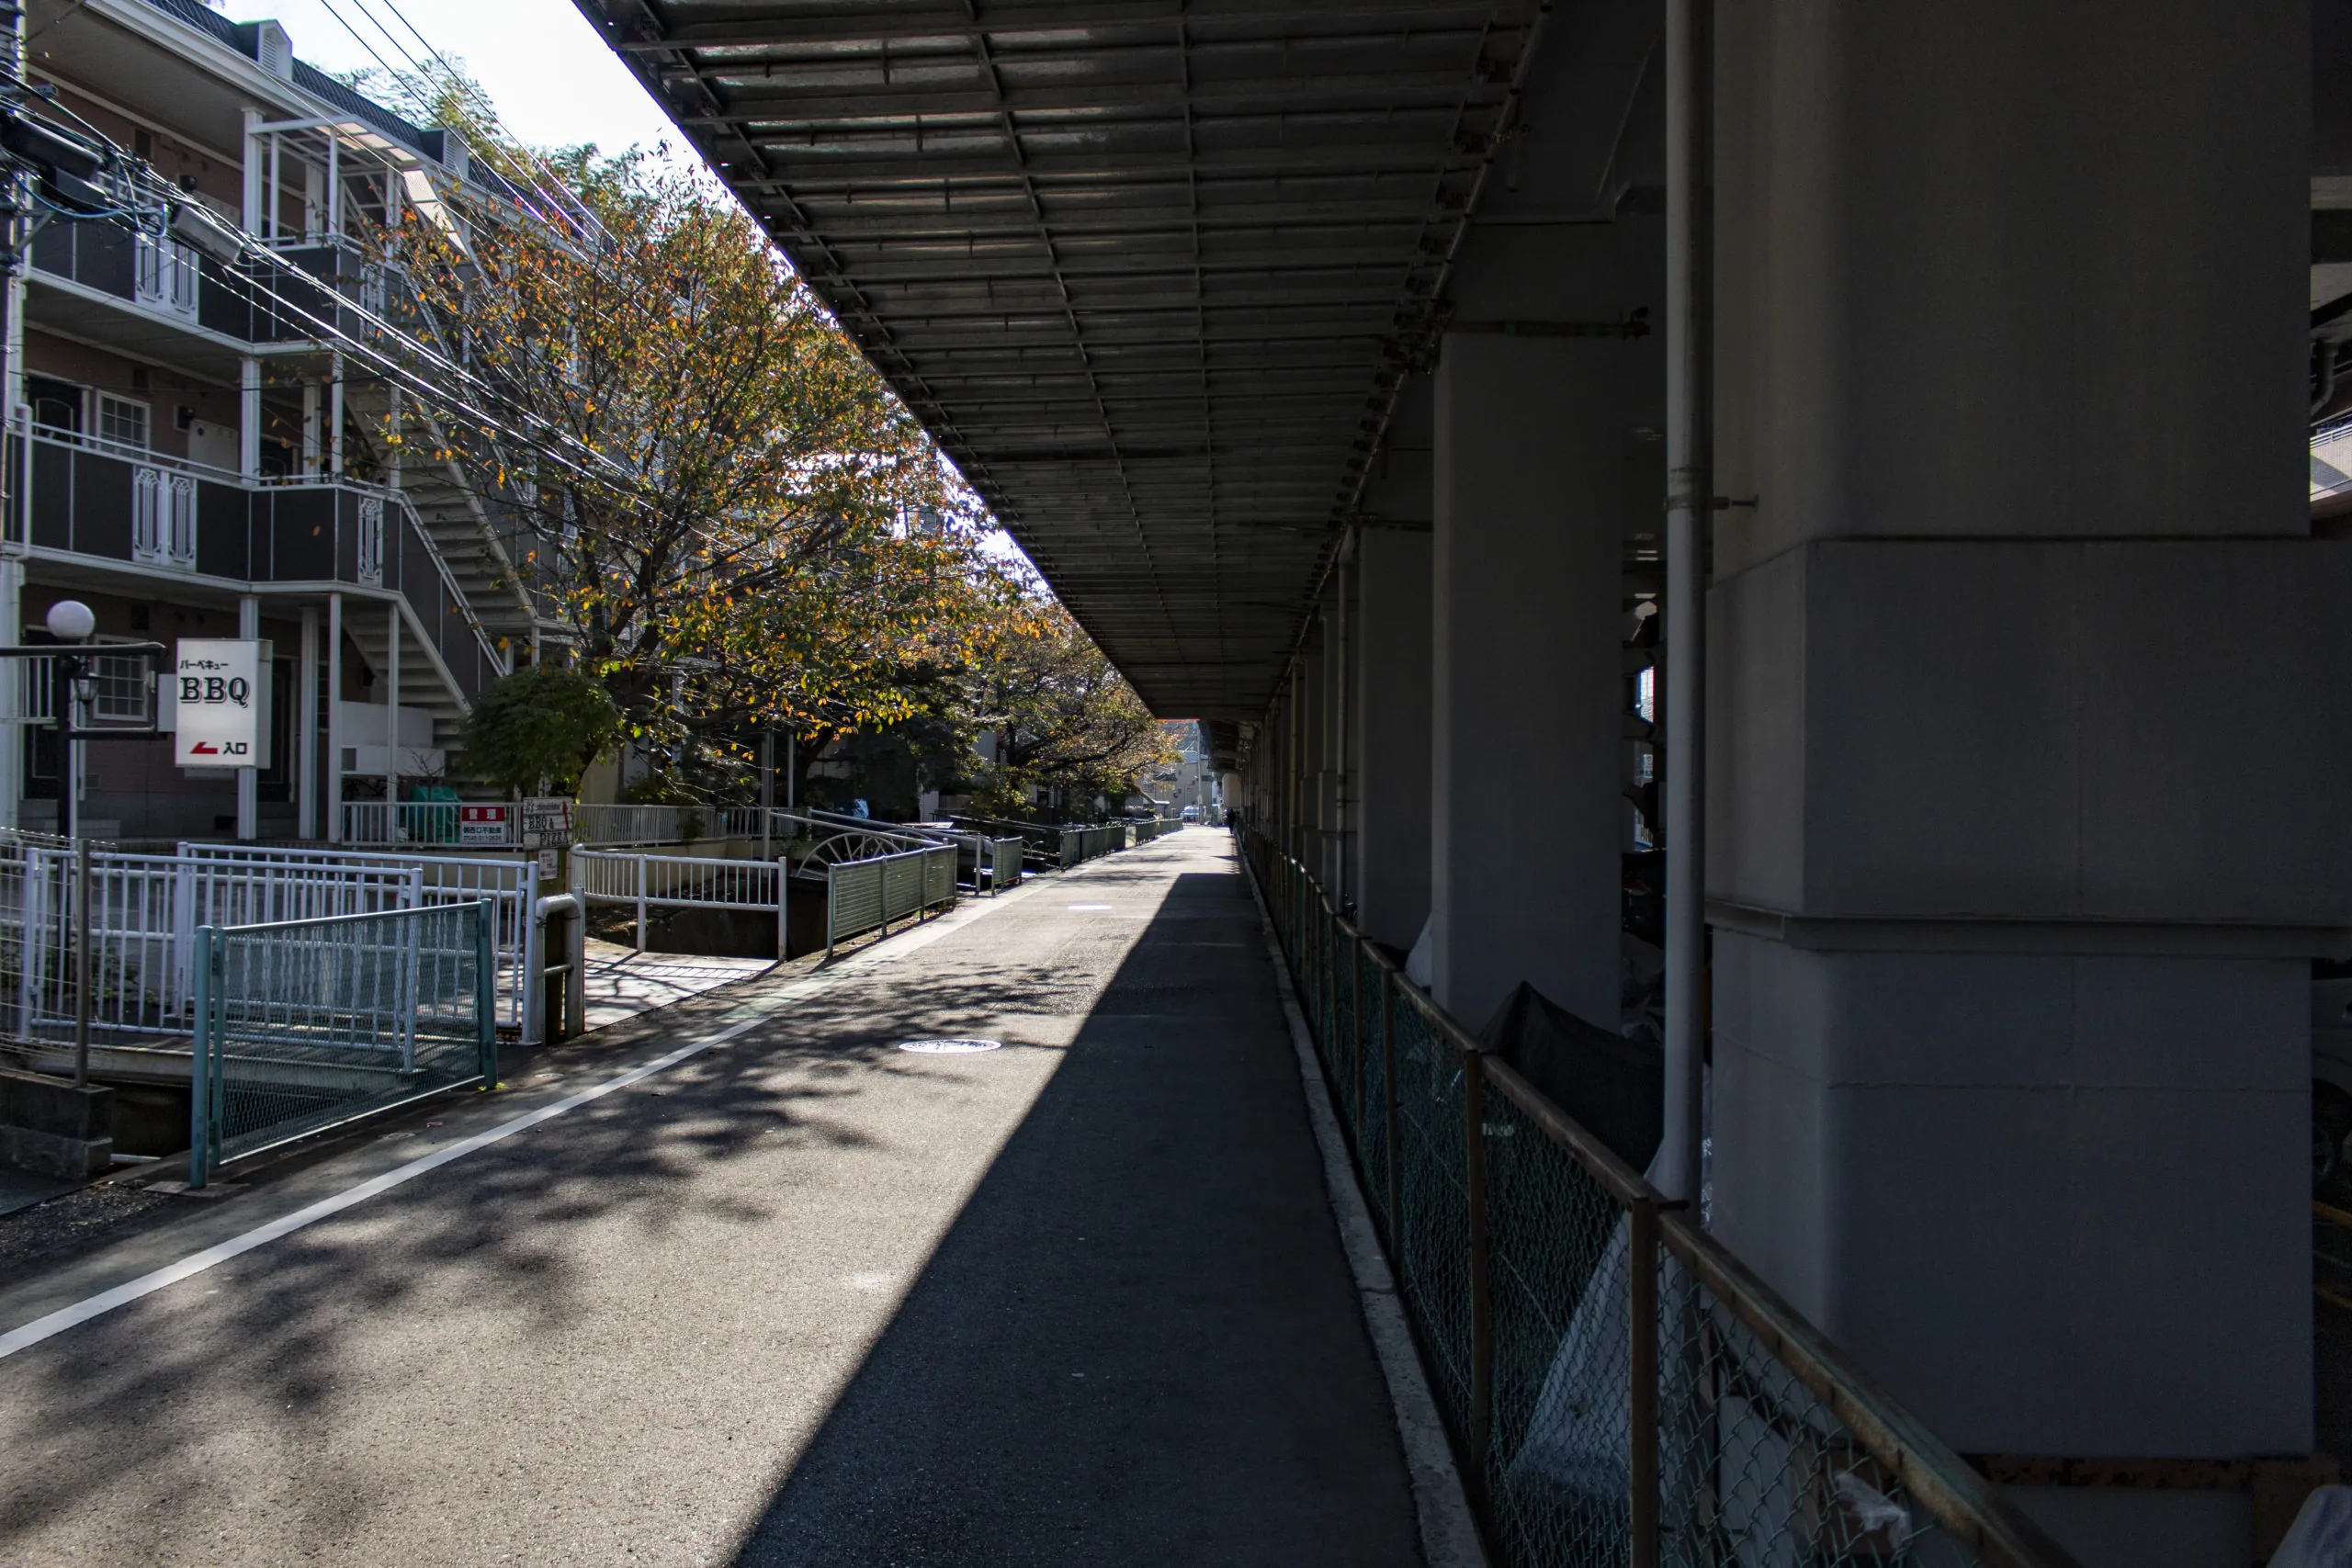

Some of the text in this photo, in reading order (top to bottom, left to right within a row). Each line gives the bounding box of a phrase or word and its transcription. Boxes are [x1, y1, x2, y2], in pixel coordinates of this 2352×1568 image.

[179, 660, 229, 670] バーベキュー
[179, 677, 250, 708] BBQ
[223, 741, 248, 755] 入口
[528, 815, 548, 832] BBQ
[540, 831, 569, 846] PIZZA
